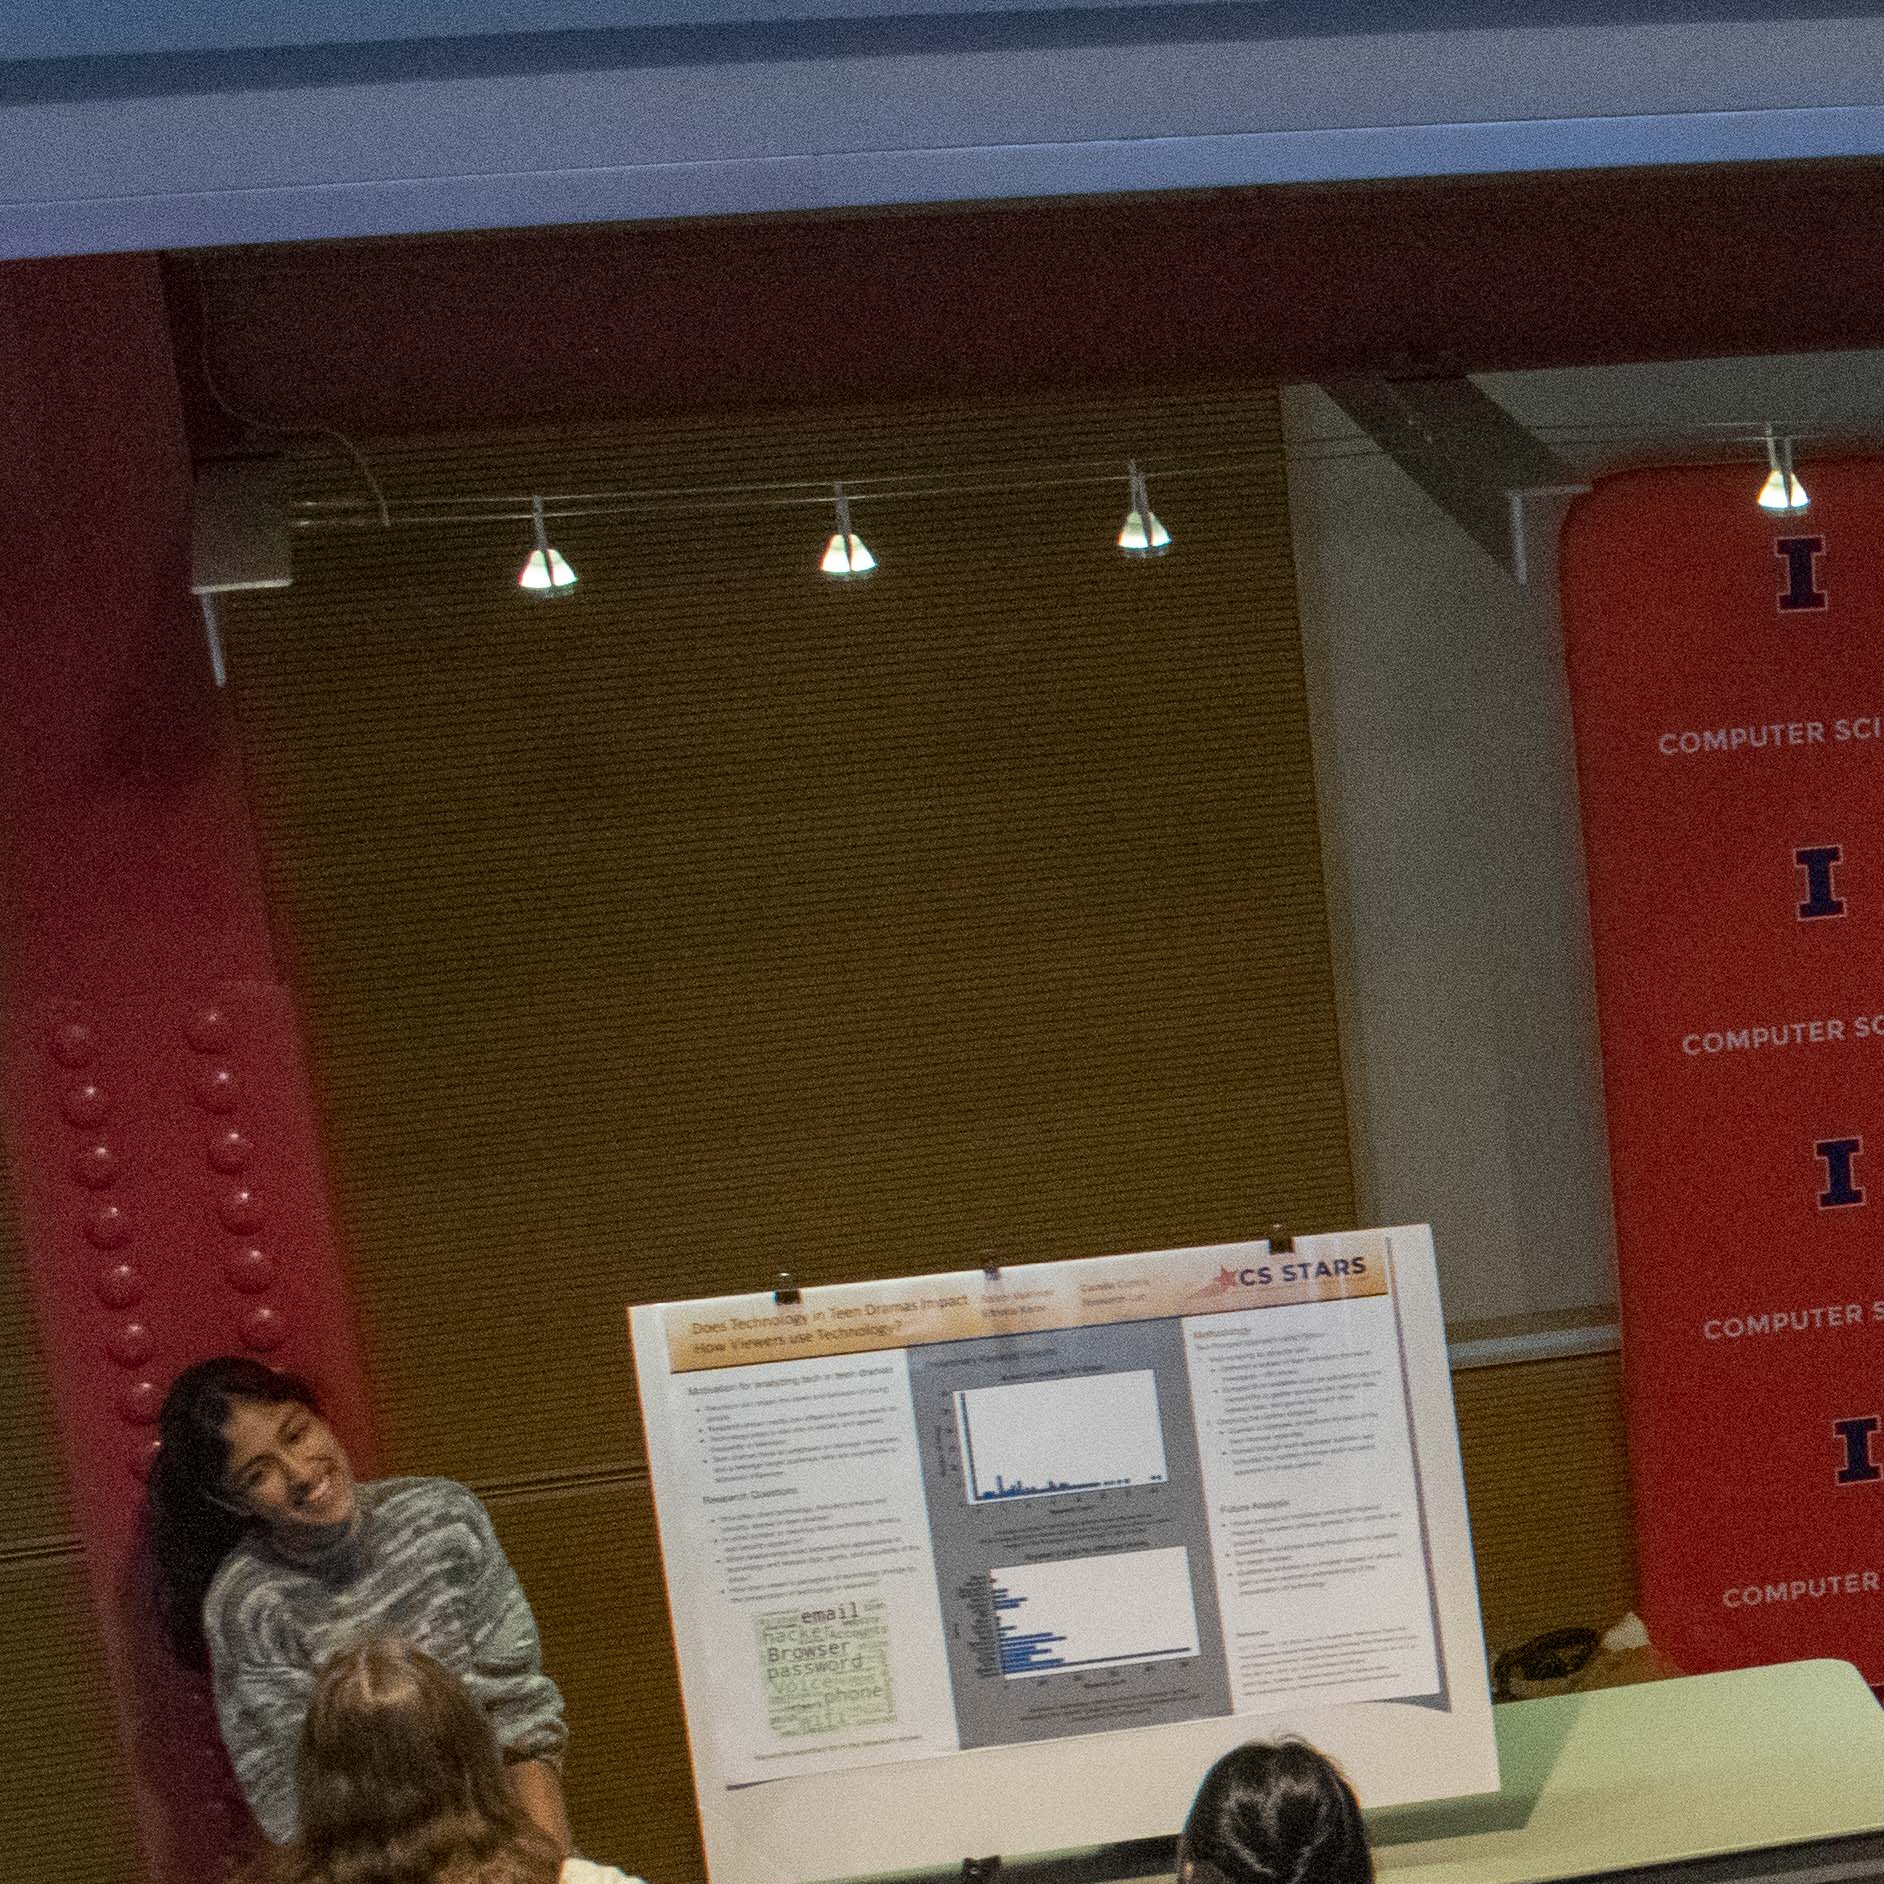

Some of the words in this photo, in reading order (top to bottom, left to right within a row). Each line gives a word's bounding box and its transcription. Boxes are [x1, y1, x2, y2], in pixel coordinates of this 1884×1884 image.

[1658, 720, 1826, 756] COMPUTER
[1682, 1020, 1845, 1056] COMPUTER
[1239, 1267, 1273, 1287] CS
[1282, 1256, 1367, 1283] STARS
[692, 1320, 727, 1335] Does
[731, 1314, 808, 1332] Technology
[812, 1310, 826, 1321] in
[829, 1306, 862, 1319] Teen
[867, 1301, 918, 1316] Dramas
[922, 1295, 968, 1311] Impact
[1703, 1305, 1863, 1341] COMPUTER
[694, 1340, 726, 1354] How
[731, 1334, 785, 1350] Viewers
[790, 1332, 813, 1344] use
[1722, 1570, 1880, 1610] COMPUTER
[801, 1601, 859, 1624] email
[767, 1653, 864, 1682] password
[768, 1641, 851, 1663] Browser
[824, 1685, 882, 1706] phone
